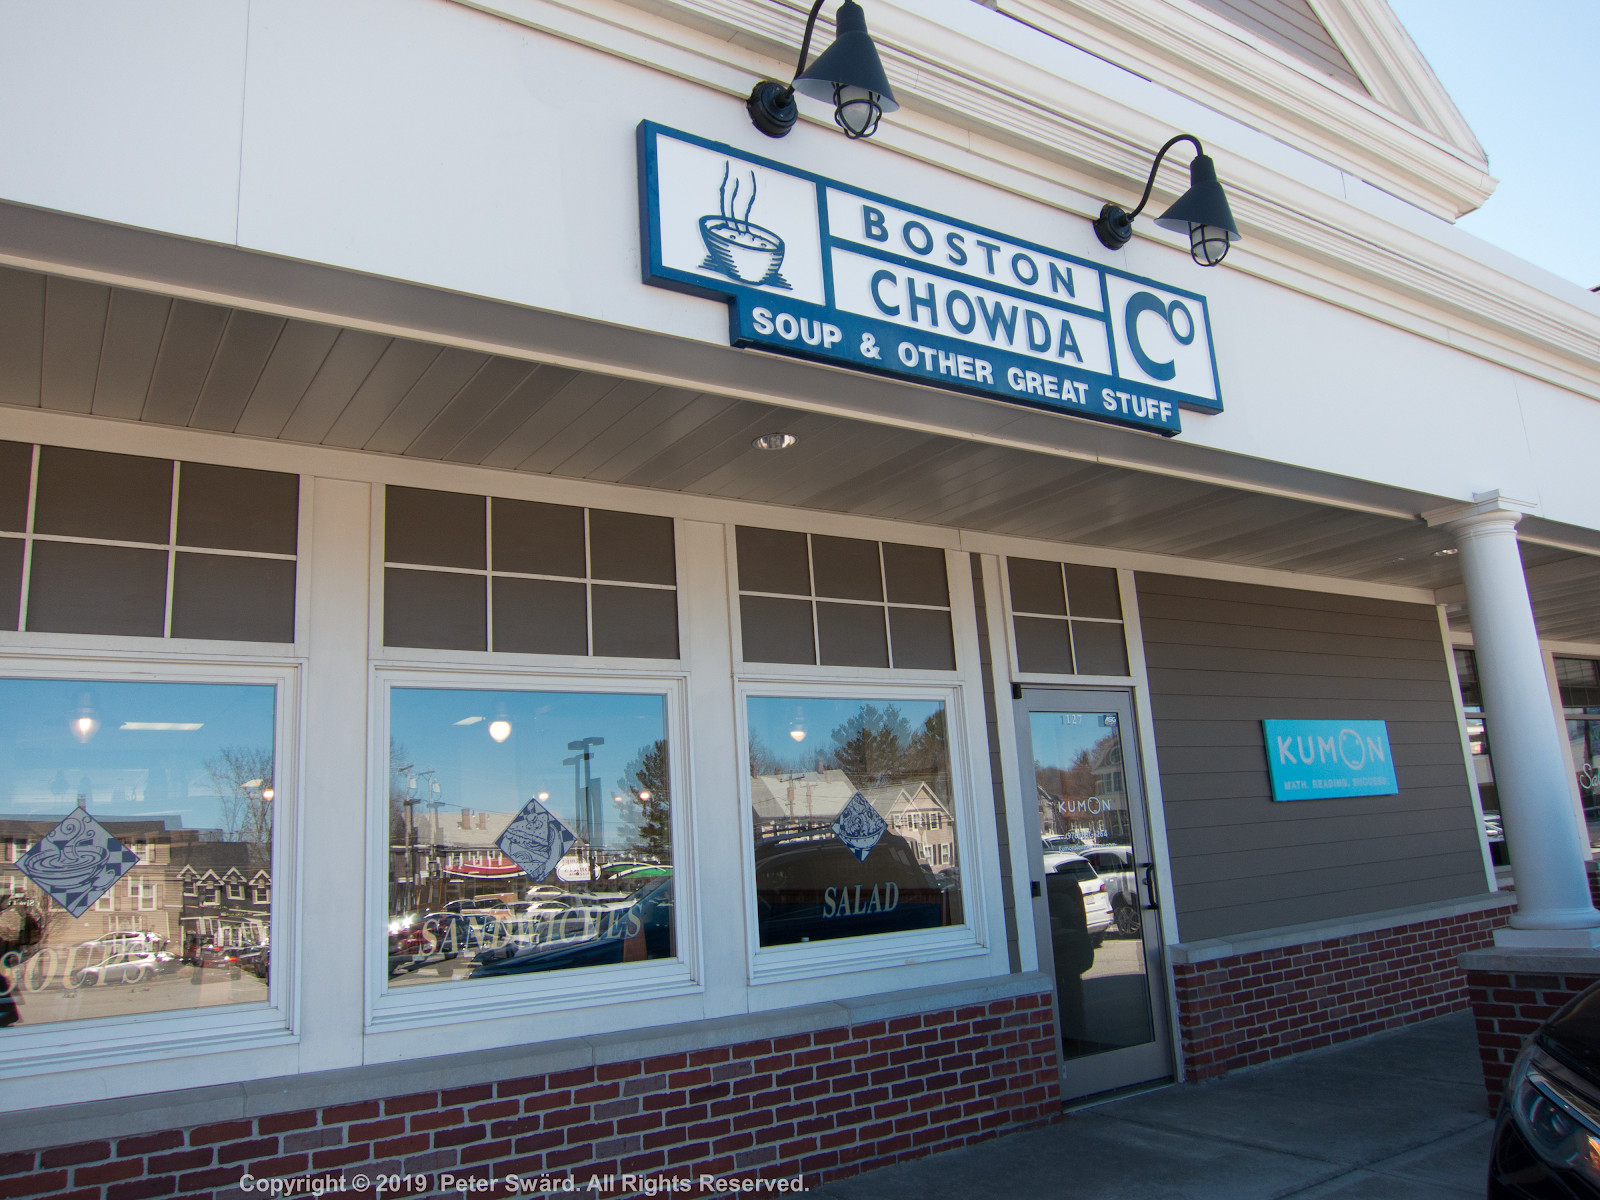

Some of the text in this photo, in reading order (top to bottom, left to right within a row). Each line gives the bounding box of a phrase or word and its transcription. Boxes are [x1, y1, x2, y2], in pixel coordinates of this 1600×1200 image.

[861, 204, 1075, 299] BOSTON
[870, 269, 1084, 363] CHOWDA
[752, 306, 1172, 423] SOUP & OTHER GREAT STUFF
[1277, 728, 1385, 770] KUMON
[1058, 797, 1111, 815] KUMON
[1284, 780, 1310, 791] MATH.
[1312, 778, 1350, 789] READING.
[823, 881, 900, 919] SALAD
[418, 903, 644, 956] SANDWICHES
[0, 939, 147, 996] SOUPS
